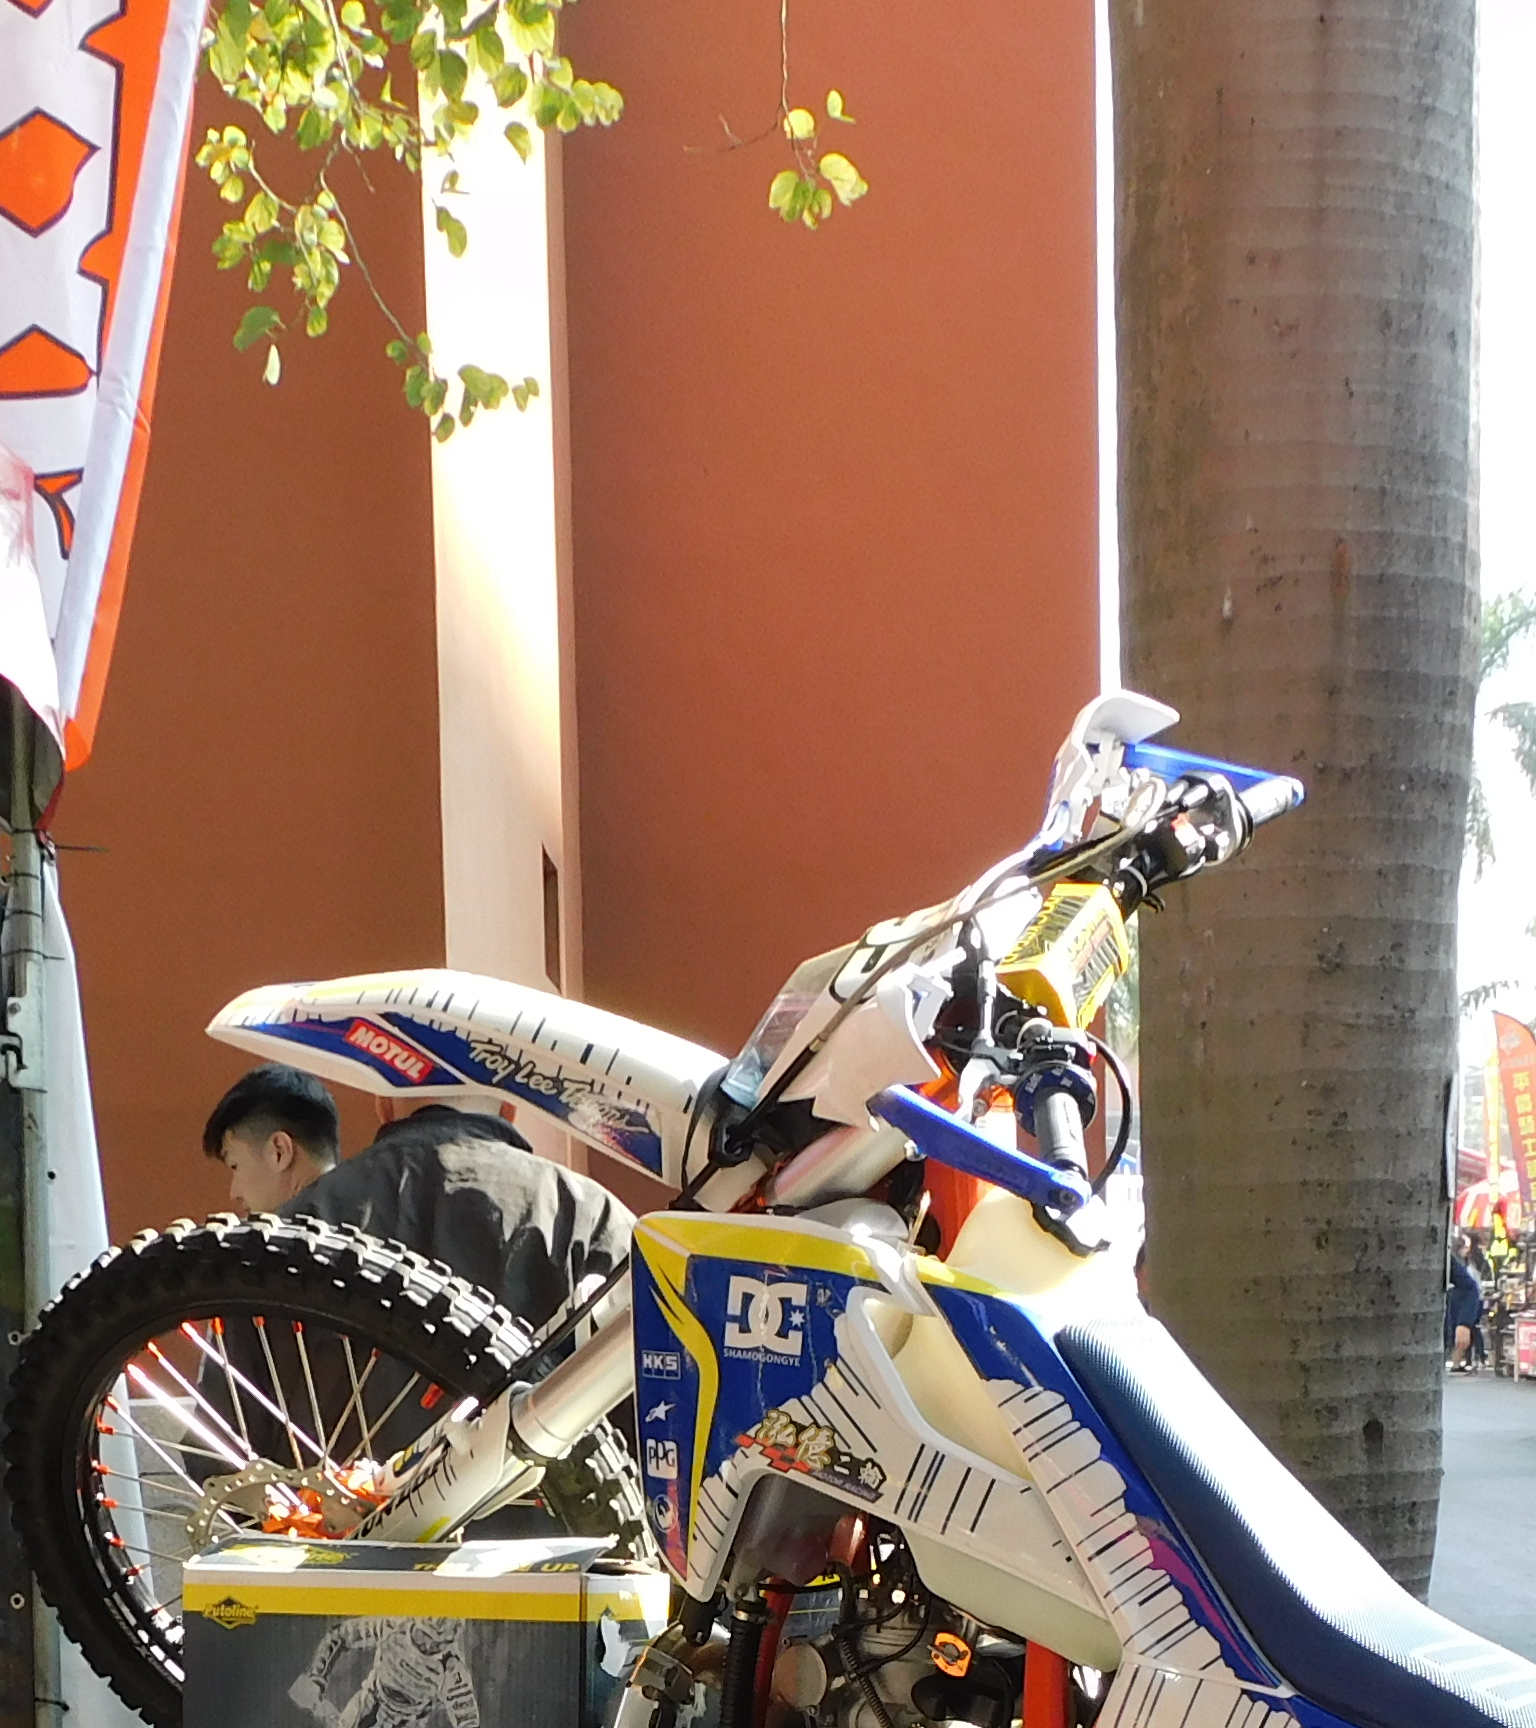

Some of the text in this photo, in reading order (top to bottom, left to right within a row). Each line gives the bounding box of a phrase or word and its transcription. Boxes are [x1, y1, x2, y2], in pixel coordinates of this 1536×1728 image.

[352, 1025, 426, 1081] MOTUL
[469, 1040, 517, 1085] Troy
[515, 1060, 558, 1095] Lee
[723, 1274, 808, 1357] DC
[643, 1351, 680, 1372] HKS
[648, 1442, 676, 1473] PPG
[540, 1562, 580, 1573] UP
[203, 1604, 255, 1620] Putoline
